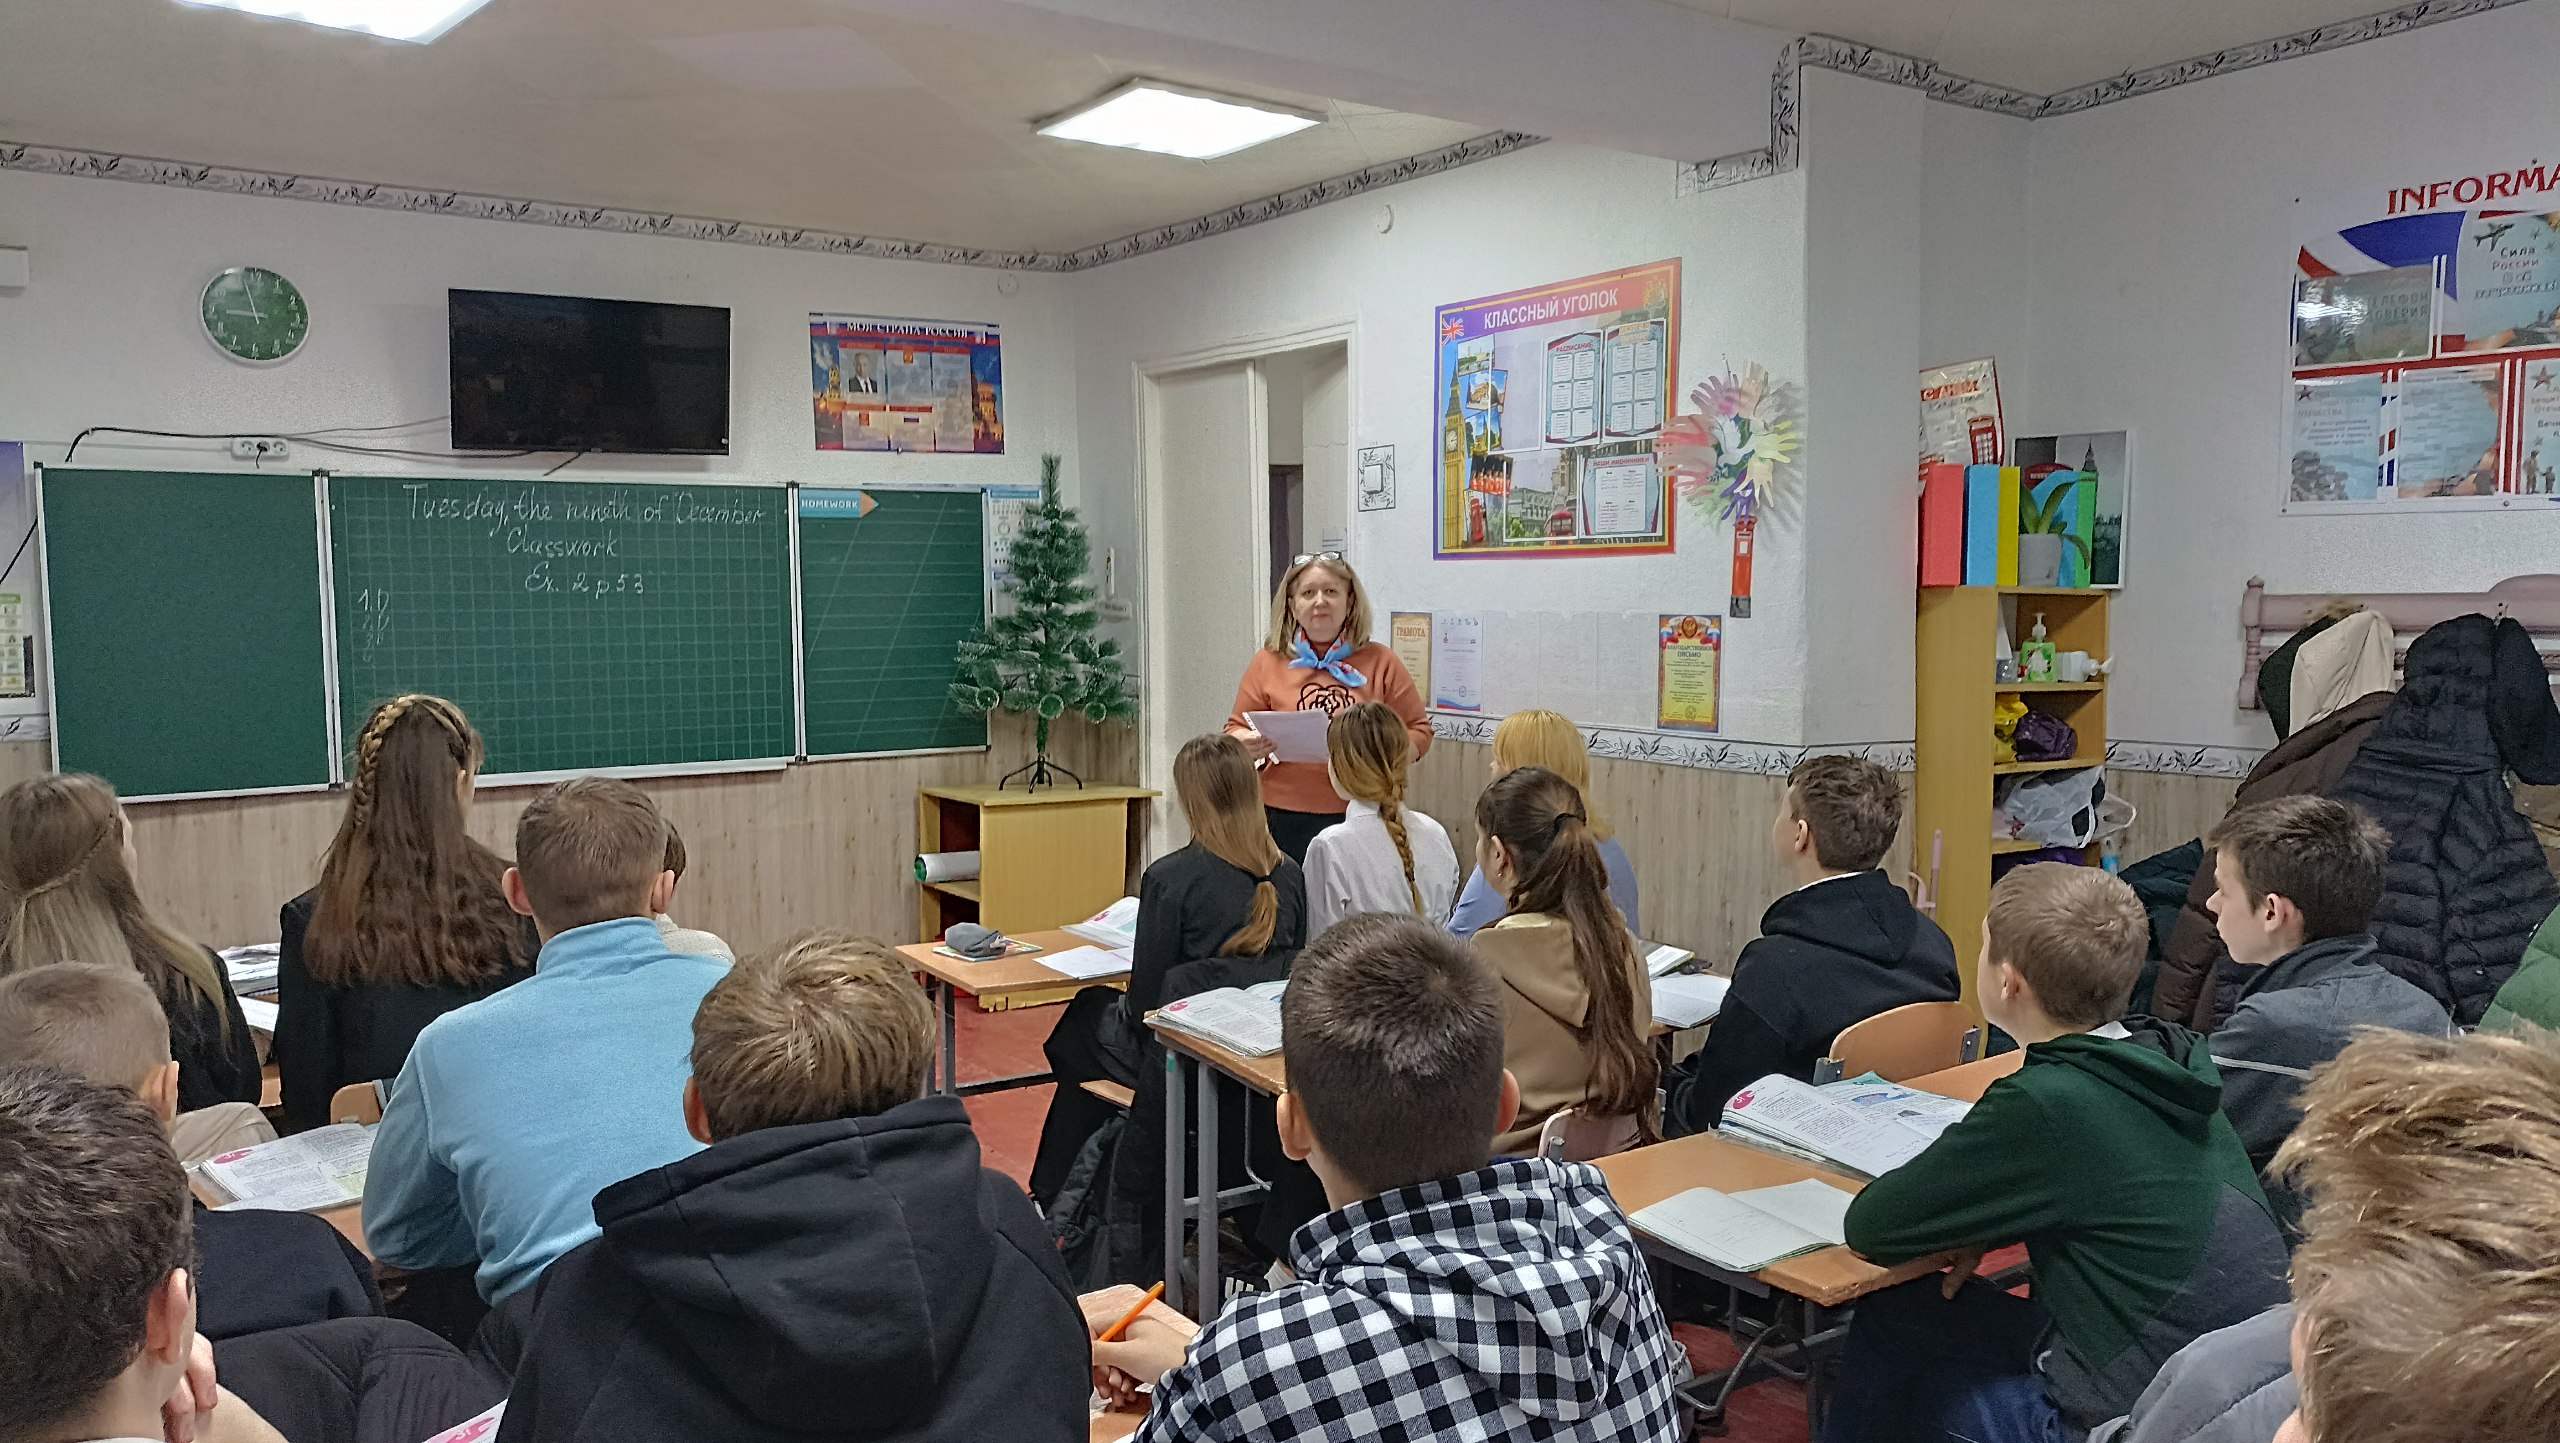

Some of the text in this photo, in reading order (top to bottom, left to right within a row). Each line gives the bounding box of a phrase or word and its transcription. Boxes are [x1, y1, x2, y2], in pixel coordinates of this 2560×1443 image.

[2501, 246, 2536, 258] Сила
[1484, 287, 1619, 330] КЛАССНЫЙ УГОЛОК
[1556, 342, 1594, 353] РАСПИСАНИЕ
[402, 483, 510, 537] Tuesday,
[513, 486, 553, 520] the
[643, 493, 669, 523] of
[673, 491, 765, 525] December
[801, 499, 859, 509] HOMEWORK
[506, 524, 618, 558] Classwork
[524, 560, 560, 593] Ex.
[572, 572, 590, 593] 2
[1396, 626, 1426, 637] ГРАМОТА
